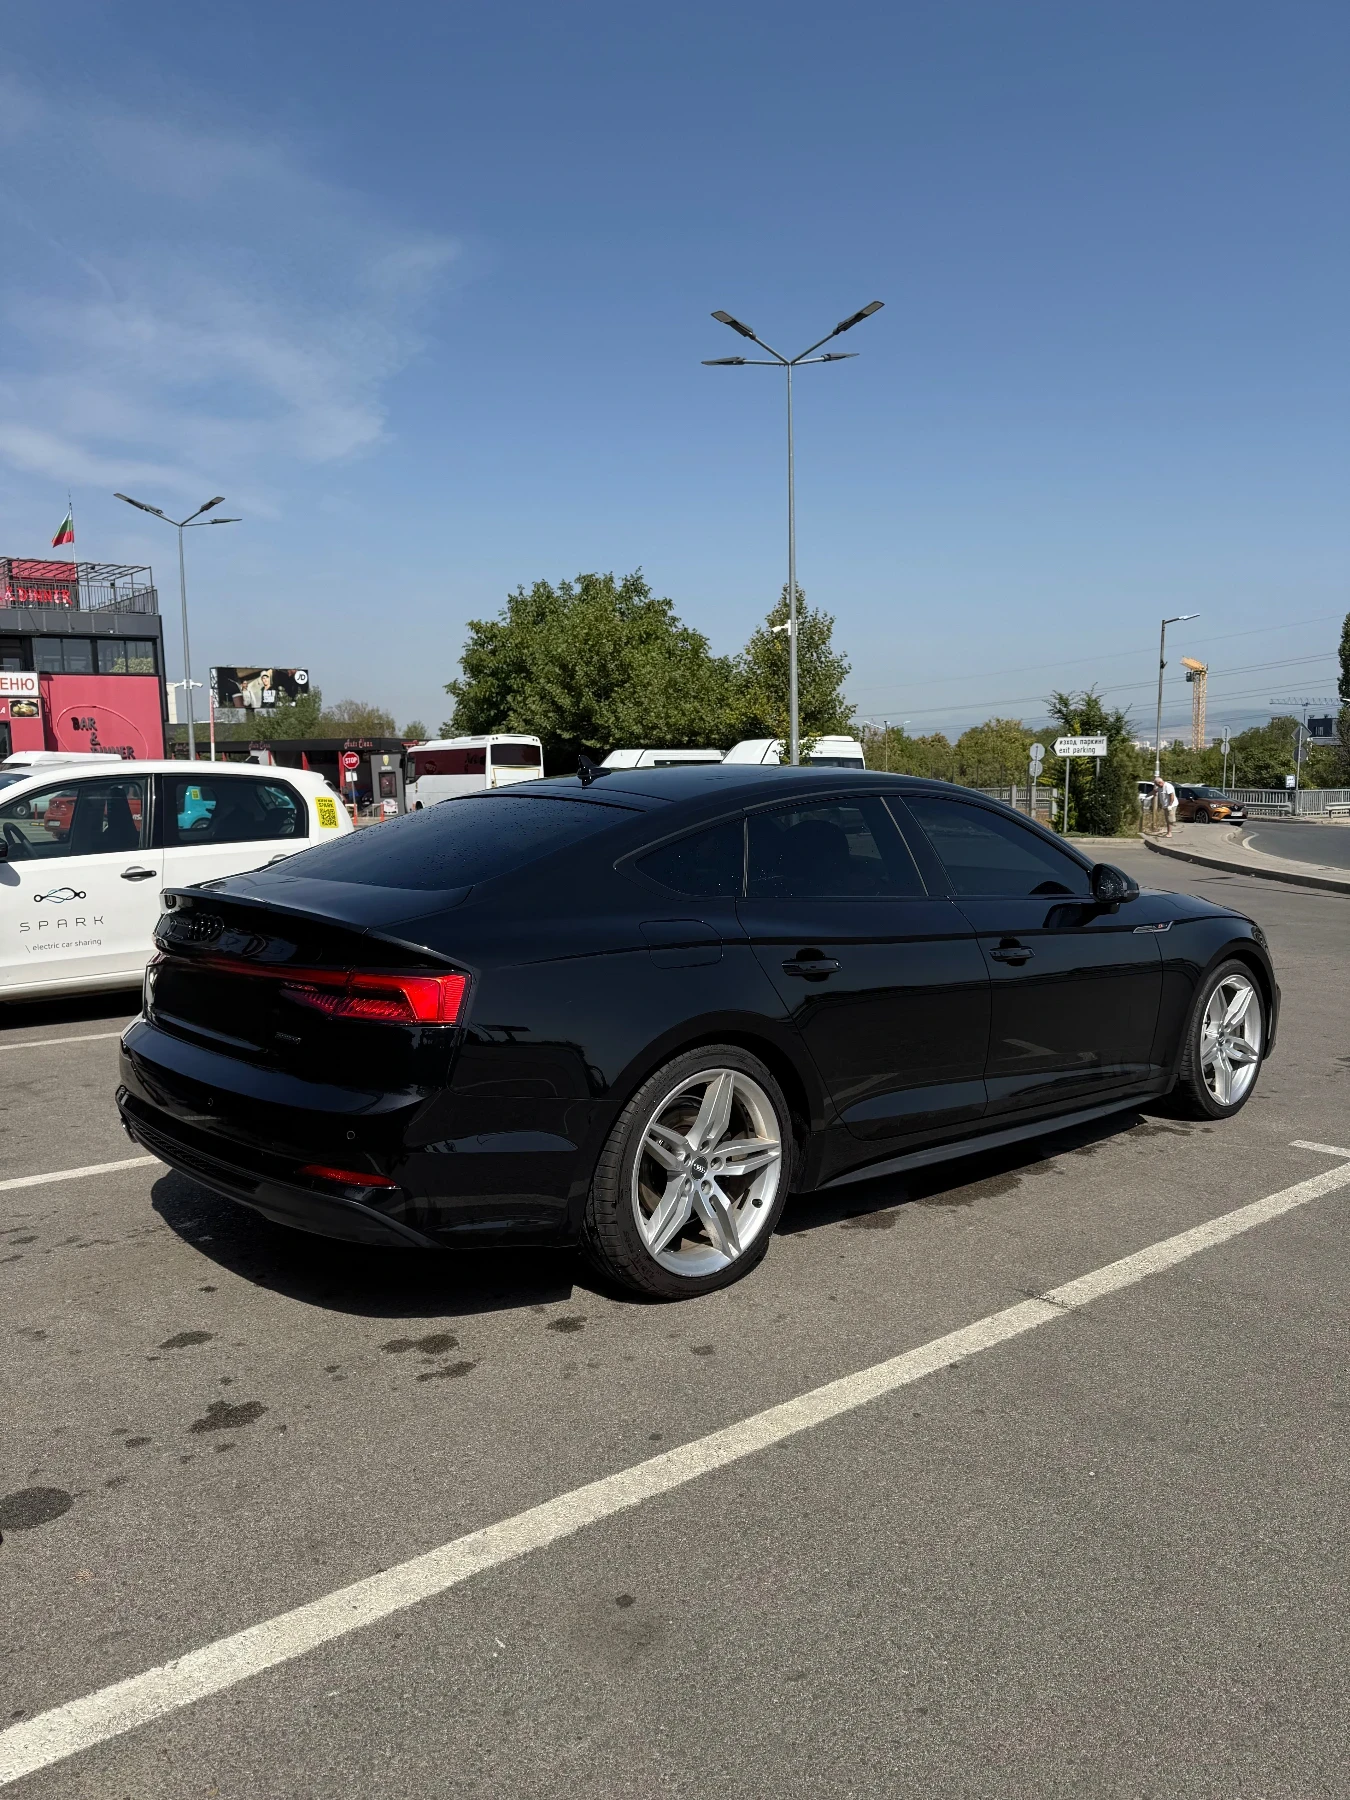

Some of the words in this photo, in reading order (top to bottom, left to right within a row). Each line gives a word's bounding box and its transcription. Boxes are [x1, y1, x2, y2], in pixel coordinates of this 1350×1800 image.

[16, 586, 73, 605] DINNER
[70, 717, 98, 732] BAR
[89, 732, 101, 746] &
[1073, 747, 1096, 755] parking
[345, 757, 358, 765] STOP
[19, 915, 104, 934] SPARK
[32, 942, 60, 951] electric
[74, 939, 102, 947] sharing
